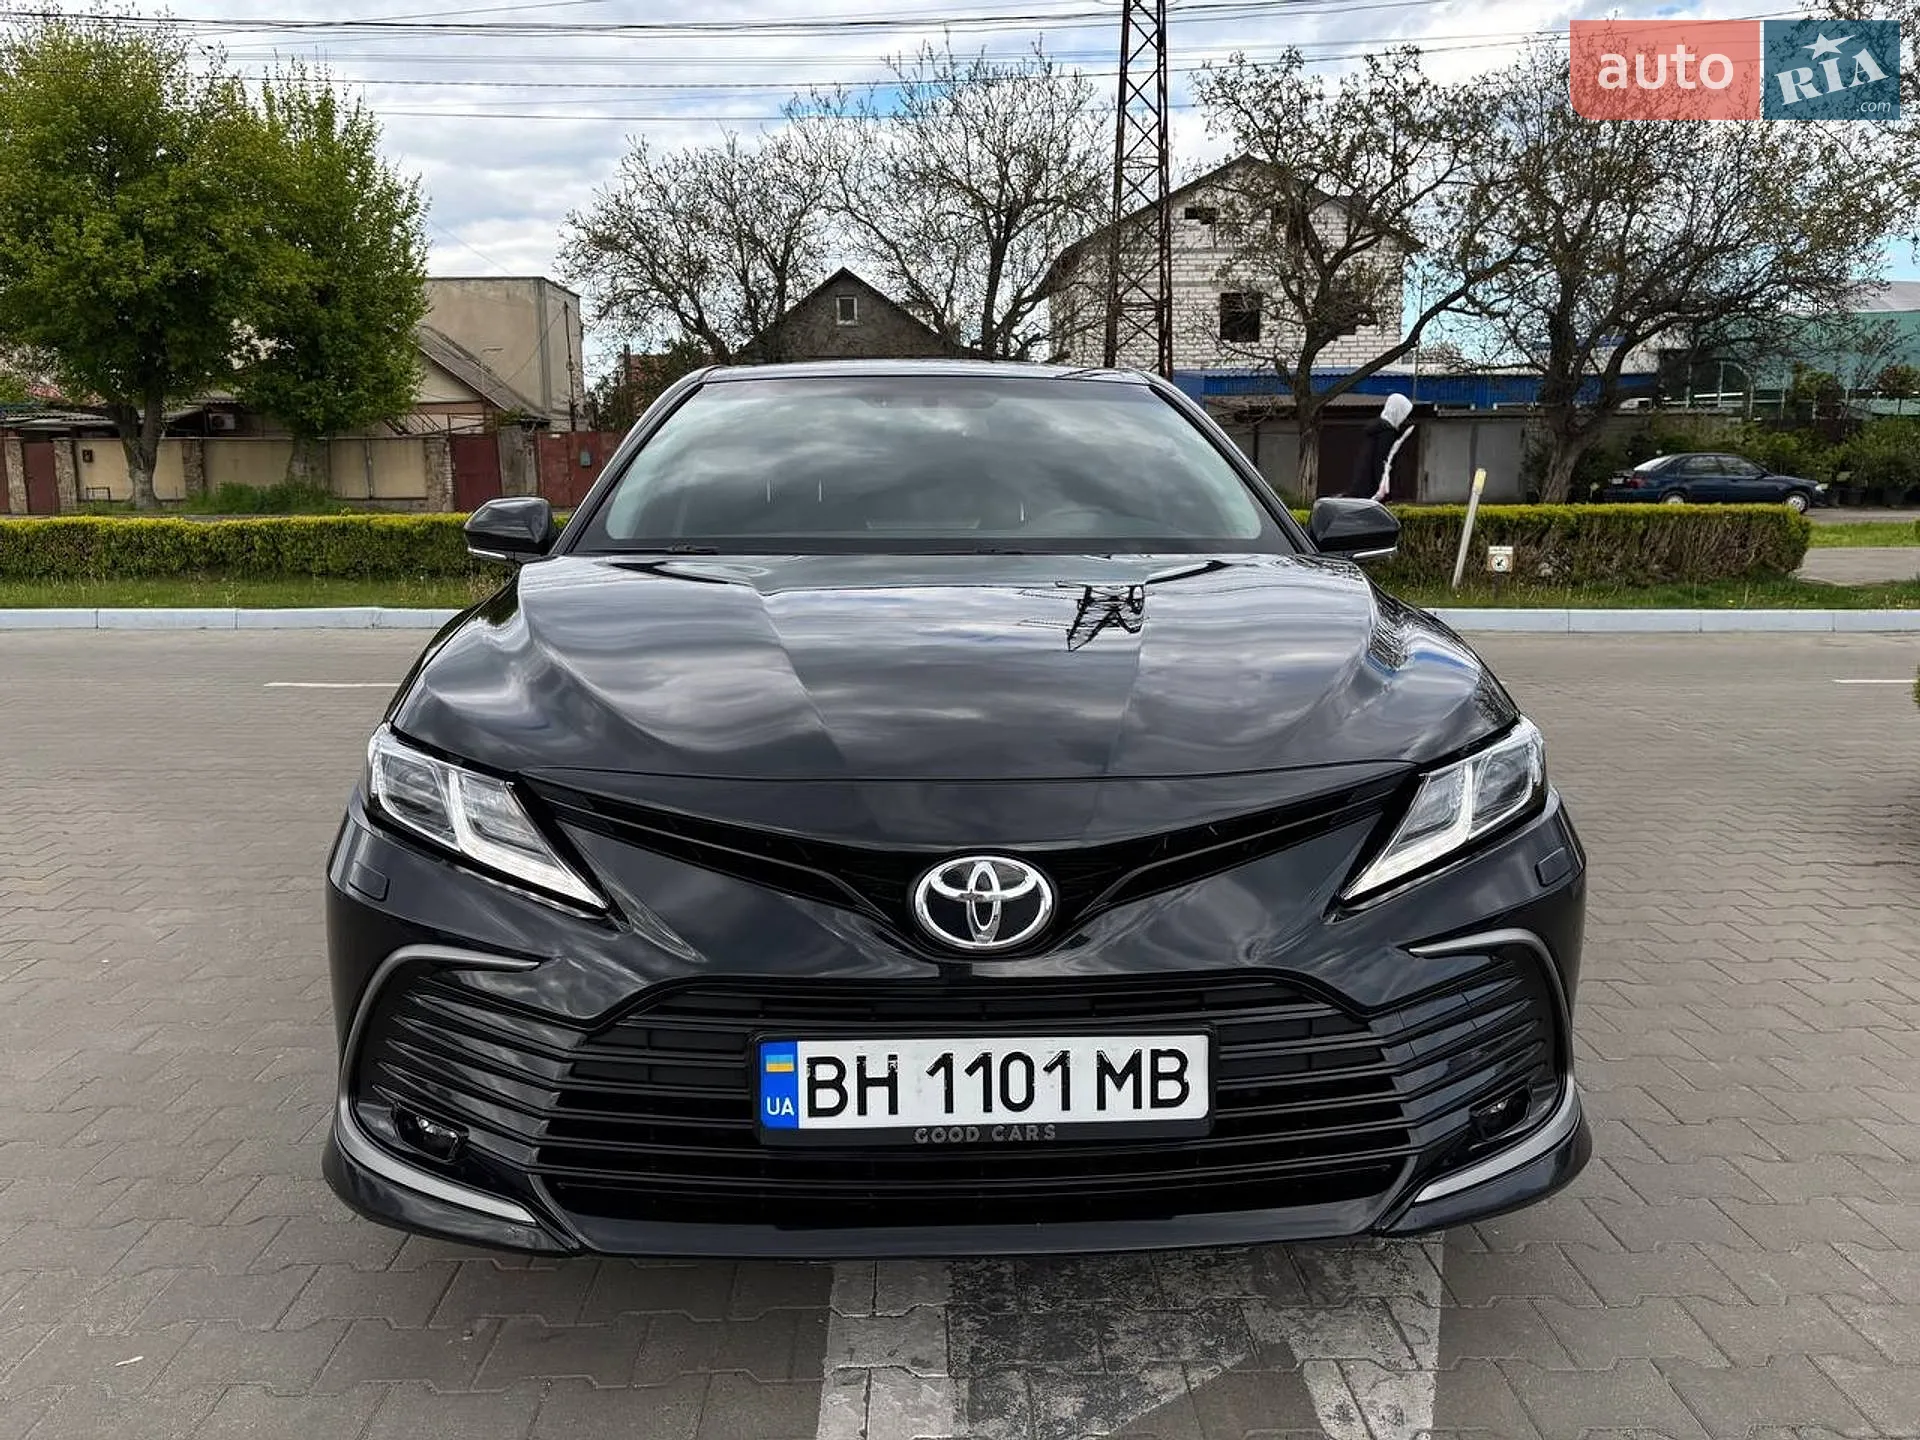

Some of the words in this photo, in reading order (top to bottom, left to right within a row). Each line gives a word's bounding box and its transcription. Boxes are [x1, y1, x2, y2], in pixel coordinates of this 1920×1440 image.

[806, 1054, 898, 1118] BH
[926, 1049, 1071, 1114] 1101
[1096, 1048, 1190, 1111] MB
[766, 1097, 795, 1116] UA
[914, 1126, 981, 1144] GOOD
[991, 1124, 1057, 1142] CARS
